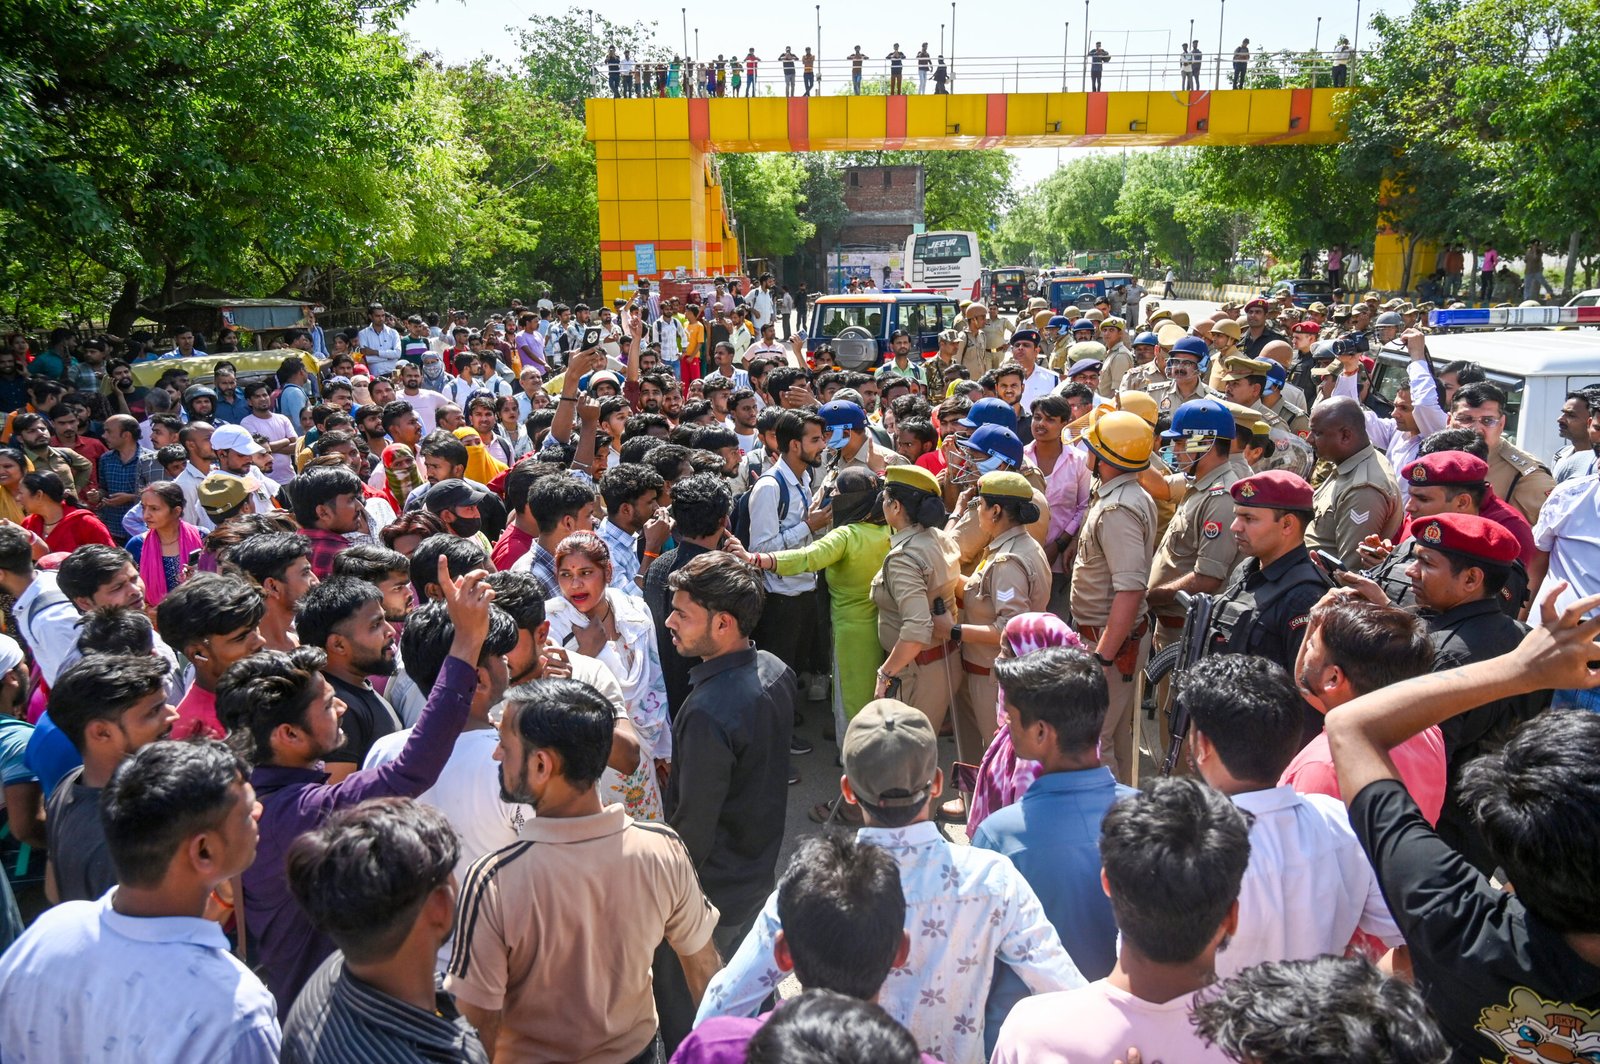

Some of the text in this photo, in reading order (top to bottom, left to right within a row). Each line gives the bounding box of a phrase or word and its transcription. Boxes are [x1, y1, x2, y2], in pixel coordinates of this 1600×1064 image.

[927, 238, 958, 249] JEEVA
[1291, 616, 1309, 627] COMM
[1555, 1016, 1574, 1026] SKY
